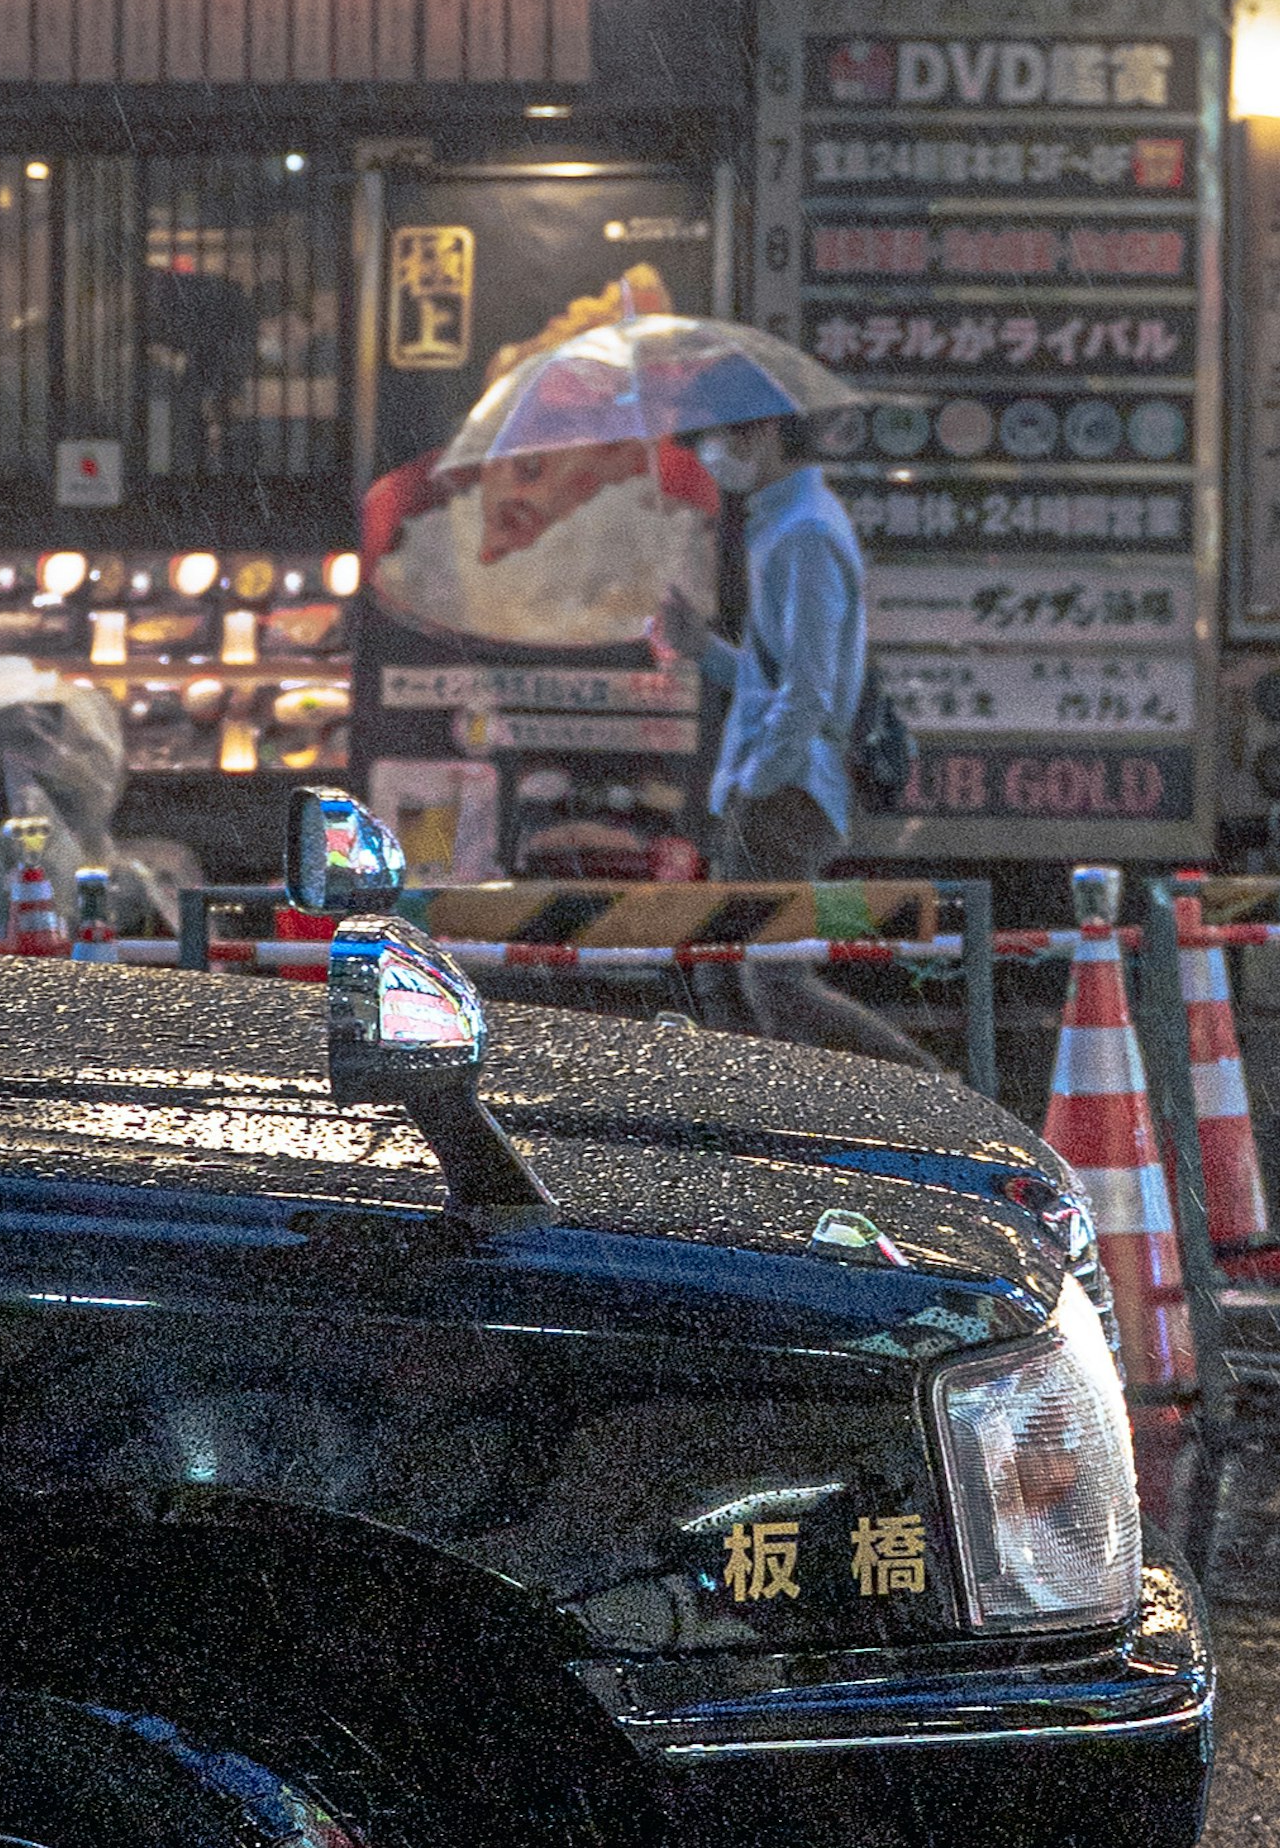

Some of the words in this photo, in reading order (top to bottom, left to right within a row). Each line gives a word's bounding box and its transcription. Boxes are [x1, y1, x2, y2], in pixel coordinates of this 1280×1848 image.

[816, 315, 1179, 366] ホテルがライバル
[1005, 755, 1164, 812] GOLD
[722, 1513, 928, 1603] 板橋
